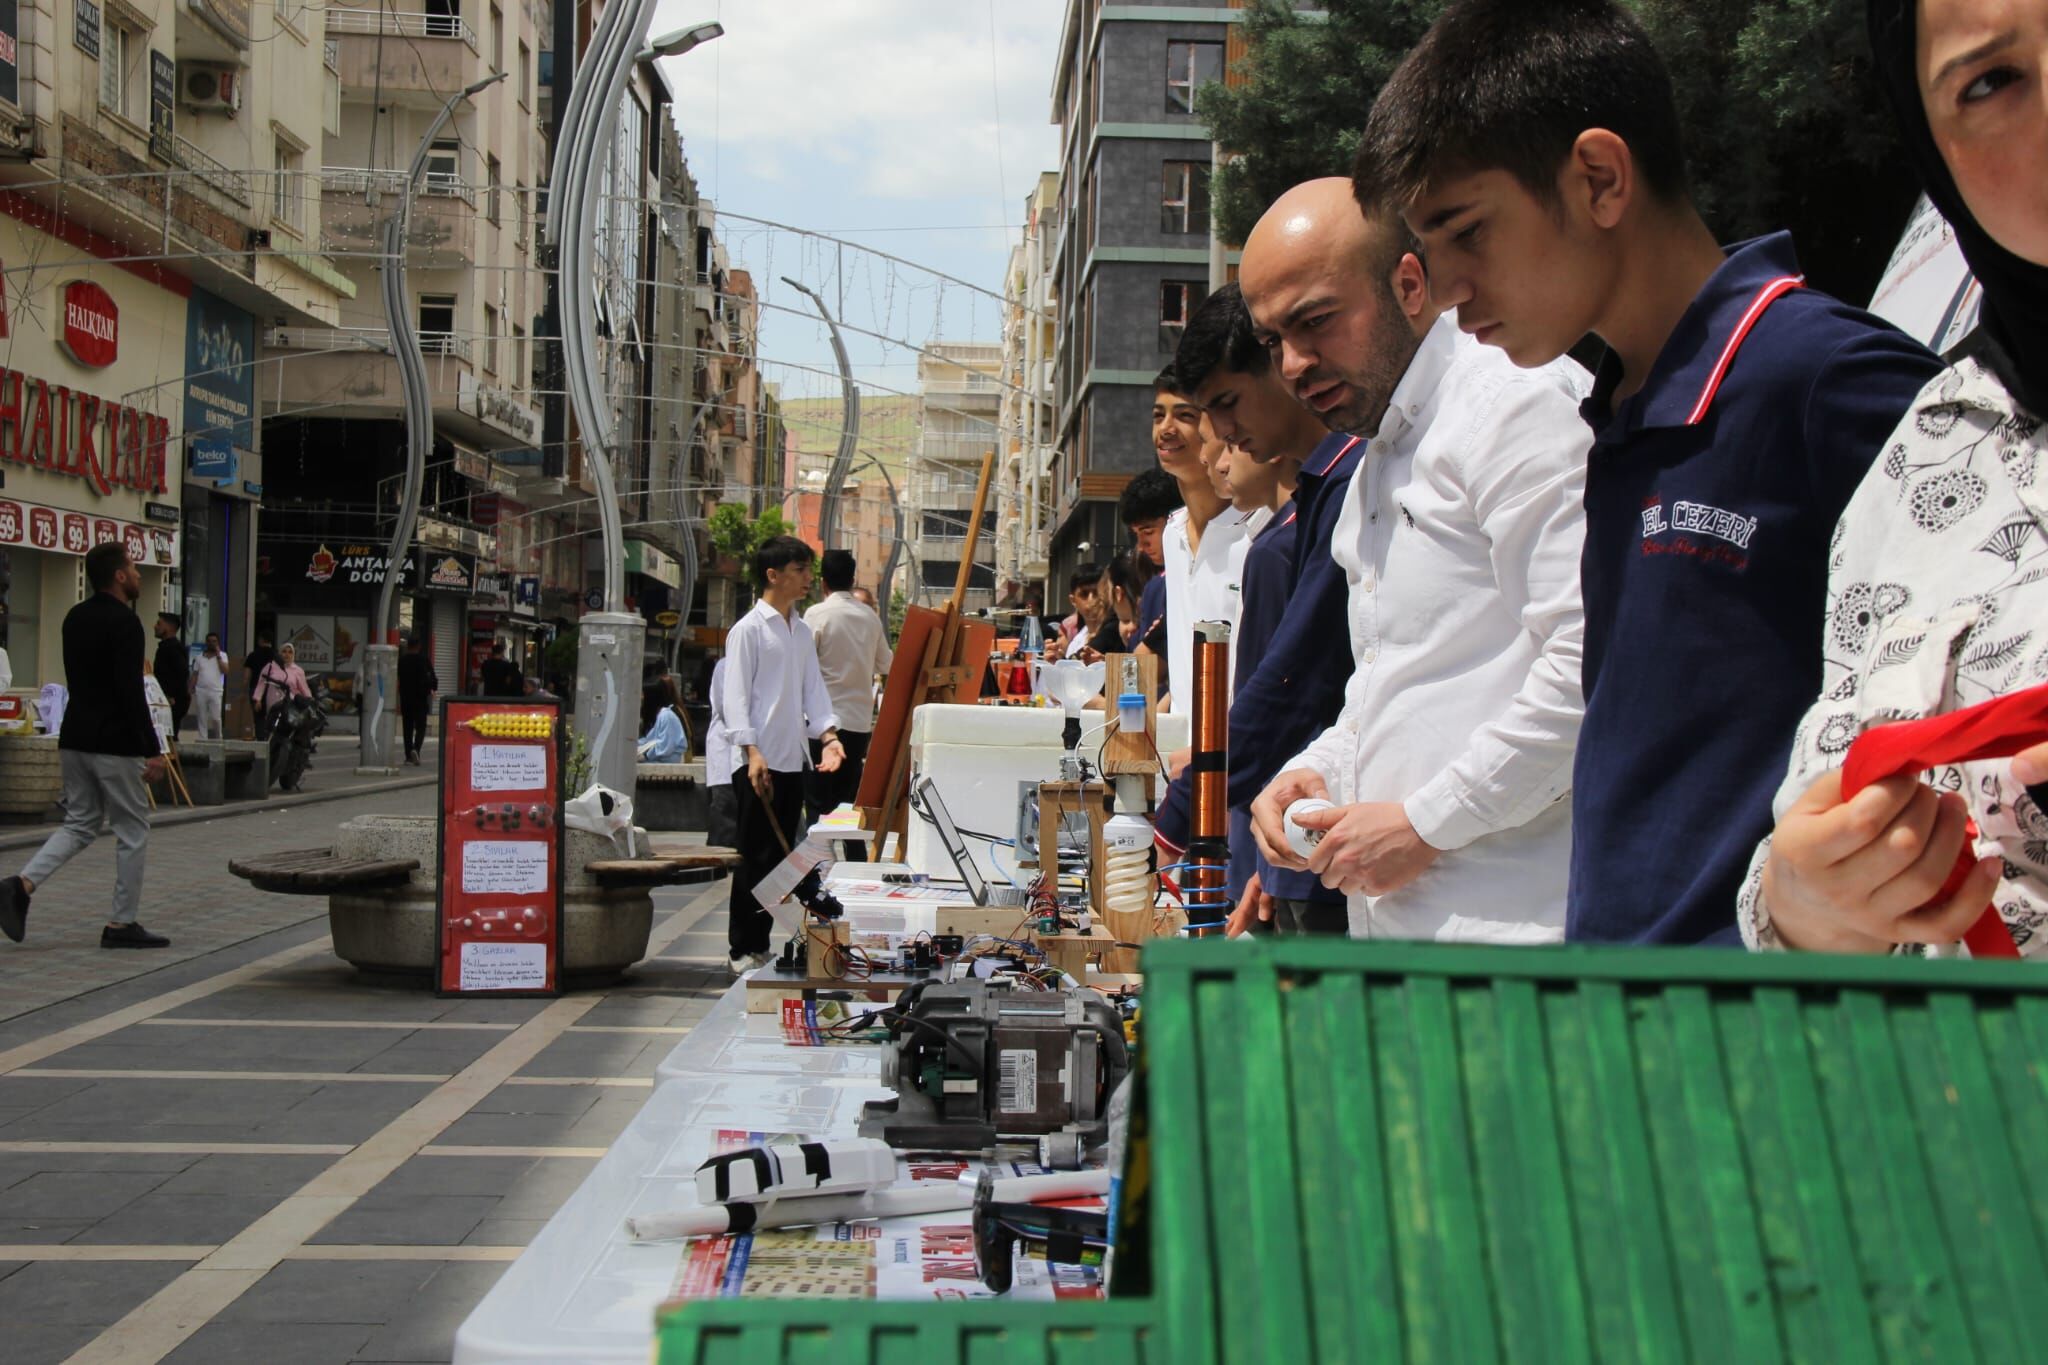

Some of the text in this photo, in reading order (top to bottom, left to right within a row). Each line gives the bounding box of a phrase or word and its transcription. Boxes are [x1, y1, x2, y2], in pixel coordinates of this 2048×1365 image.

[67, 303, 115, 342] HALKTAN
[0, 366, 169, 496] HALKTAN
[197, 449, 227, 461] beko
[0, 514, 16, 540] 59
[36, 520, 51, 546] 79
[1641, 500, 1757, 549] EL CEZERİ
[69, 526, 83, 551] 99
[341, 544, 370, 556] LÜKS
[349, 568, 406, 584] DÖNR
